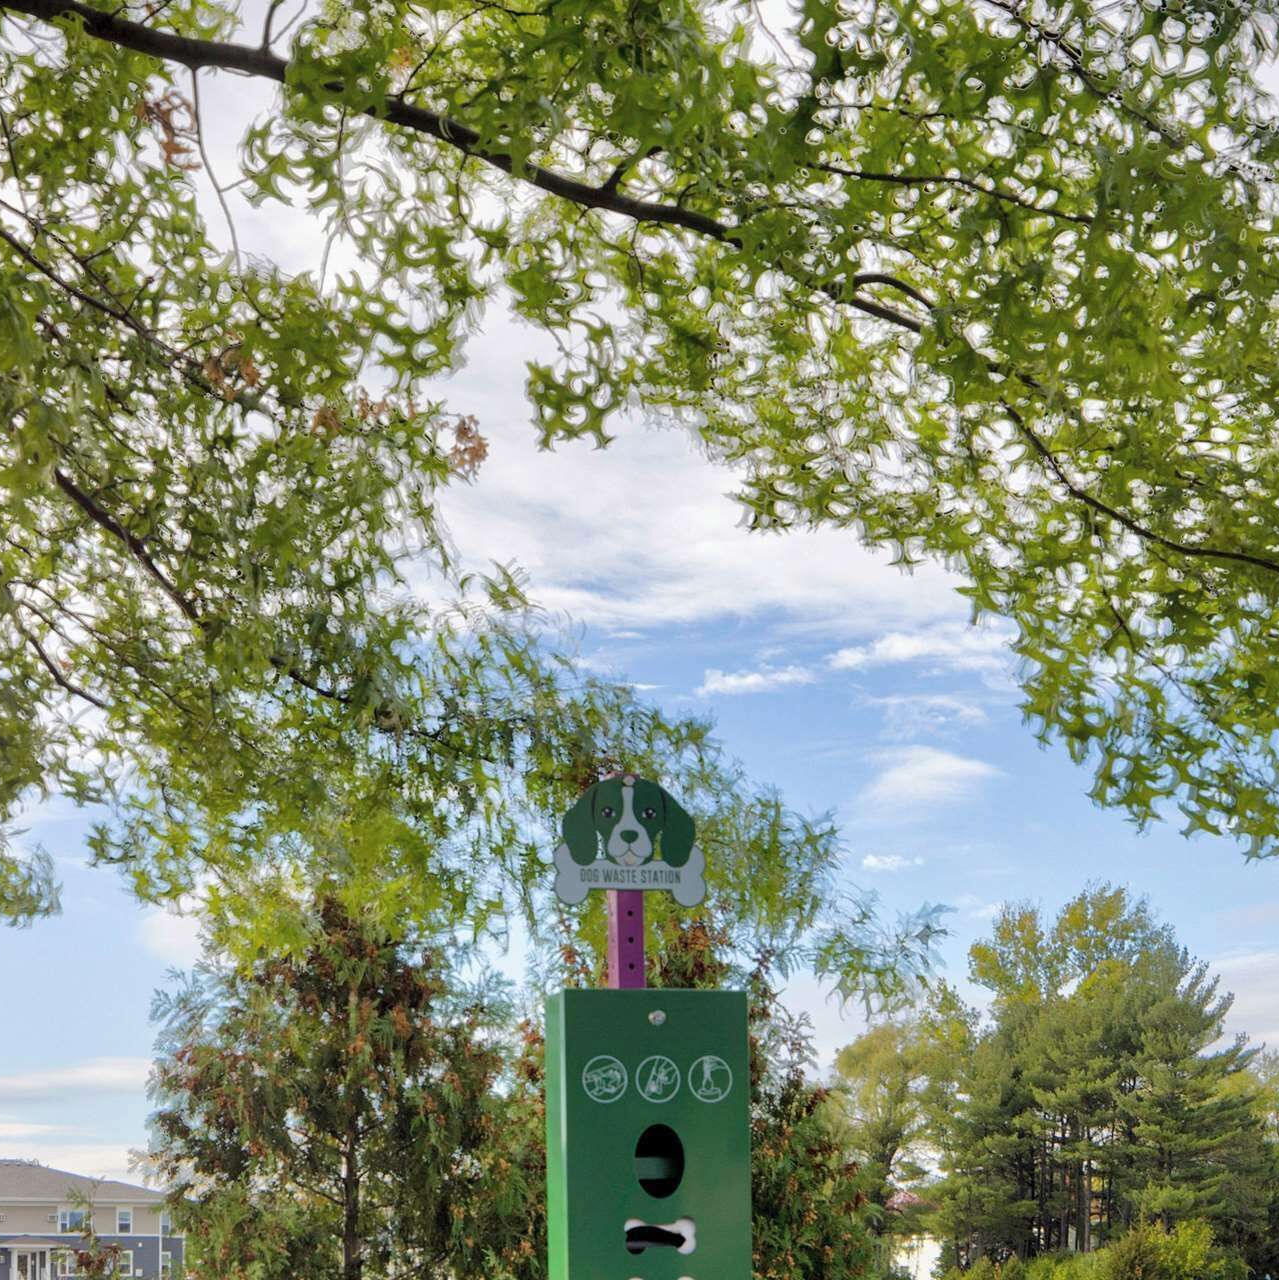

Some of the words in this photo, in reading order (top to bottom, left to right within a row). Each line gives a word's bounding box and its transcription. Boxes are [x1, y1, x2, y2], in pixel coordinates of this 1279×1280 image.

[580, 868, 600, 883] DOG
[602, 868, 637, 884] WASTE
[640, 869, 681, 884] STATION
